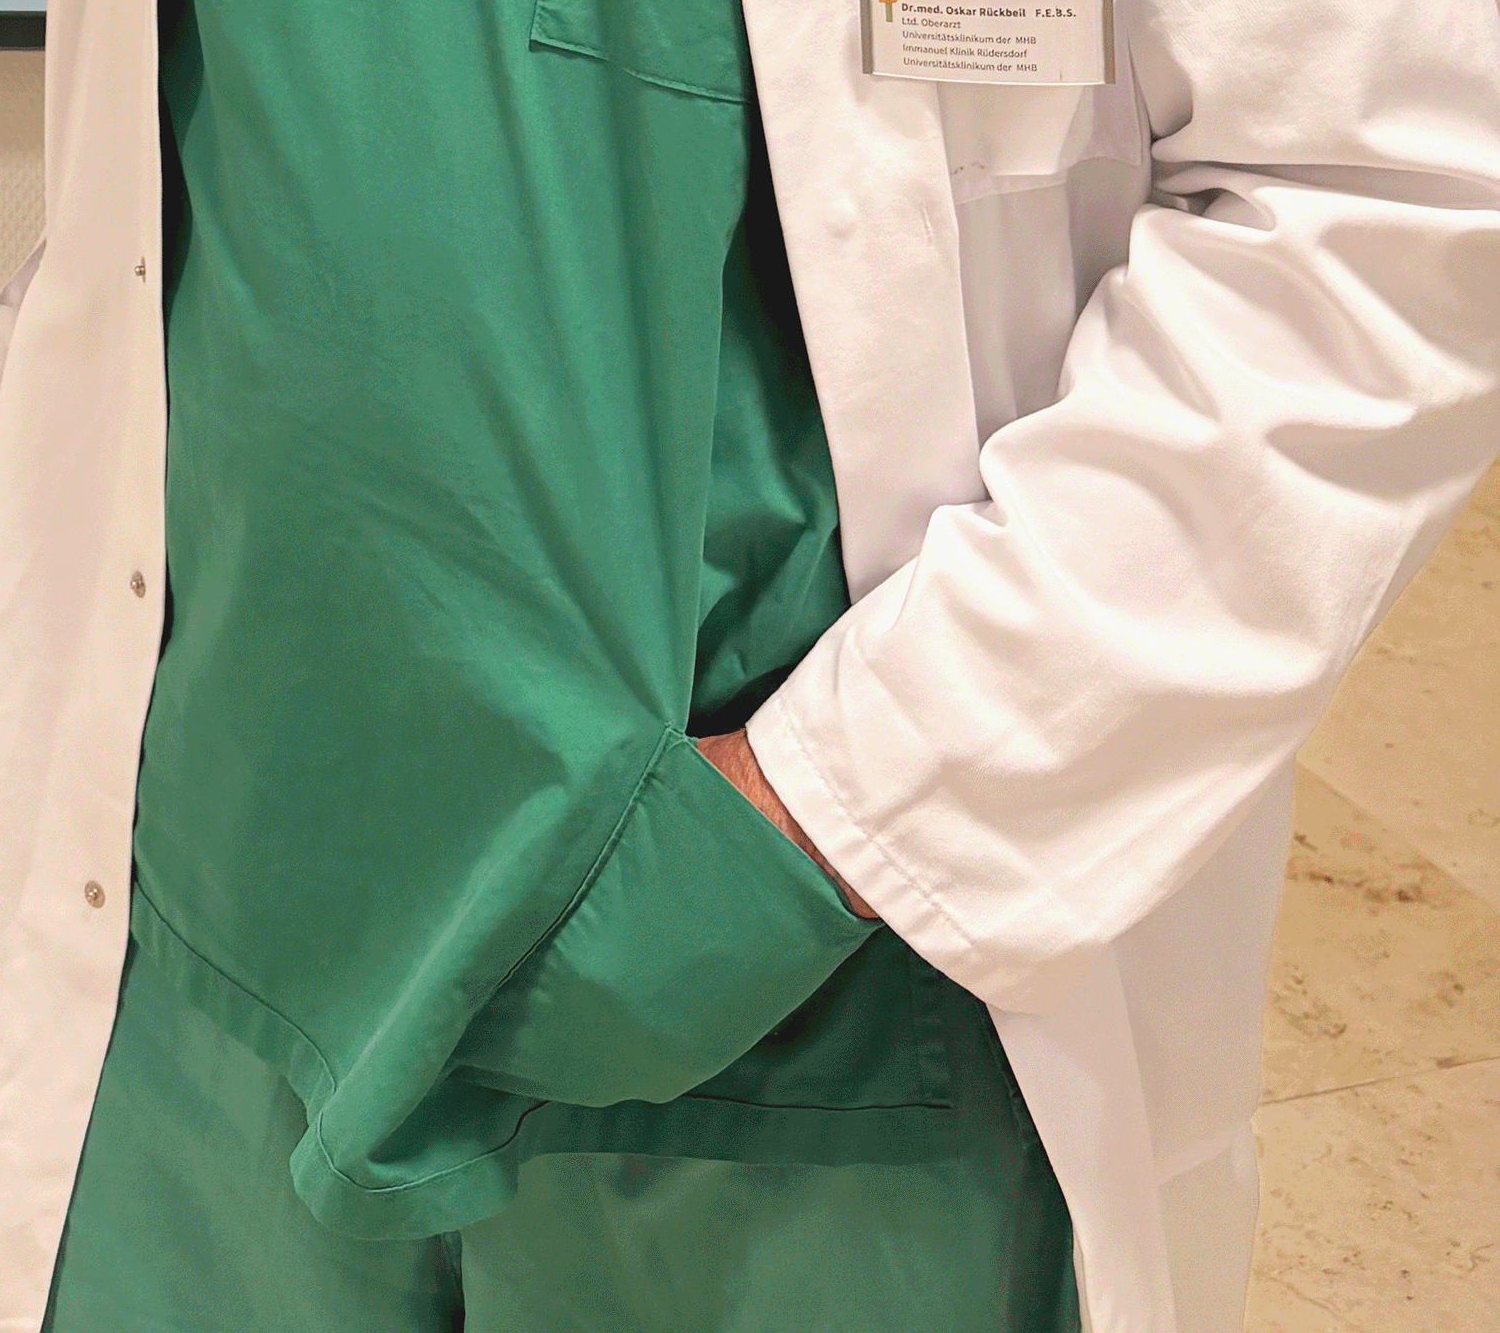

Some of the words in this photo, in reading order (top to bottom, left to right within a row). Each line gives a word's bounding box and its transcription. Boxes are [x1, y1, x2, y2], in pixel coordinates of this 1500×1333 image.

[901, 2, 944, 15] Dr.med.
[945, 6, 977, 16] Oskar
[979, 7, 1026, 18] Rückbeil
[1035, 8, 1077, 18] F.E.B.S.
[901, 17, 920, 26] Ltd.
[921, 18, 962, 29] Oberarzt
[902, 30, 995, 44] Universitätsklinikum
[995, 35, 1012, 45] der
[1015, 36, 1037, 45] MHB
[902, 44, 948, 56] Immanuel
[949, 47, 975, 57] Klinik
[976, 48, 1028, 58] Rüdersdorf
[902, 57, 995, 72] Universitätsklinikum
[996, 62, 1012, 72] der
[1016, 63, 1038, 72] MHB
